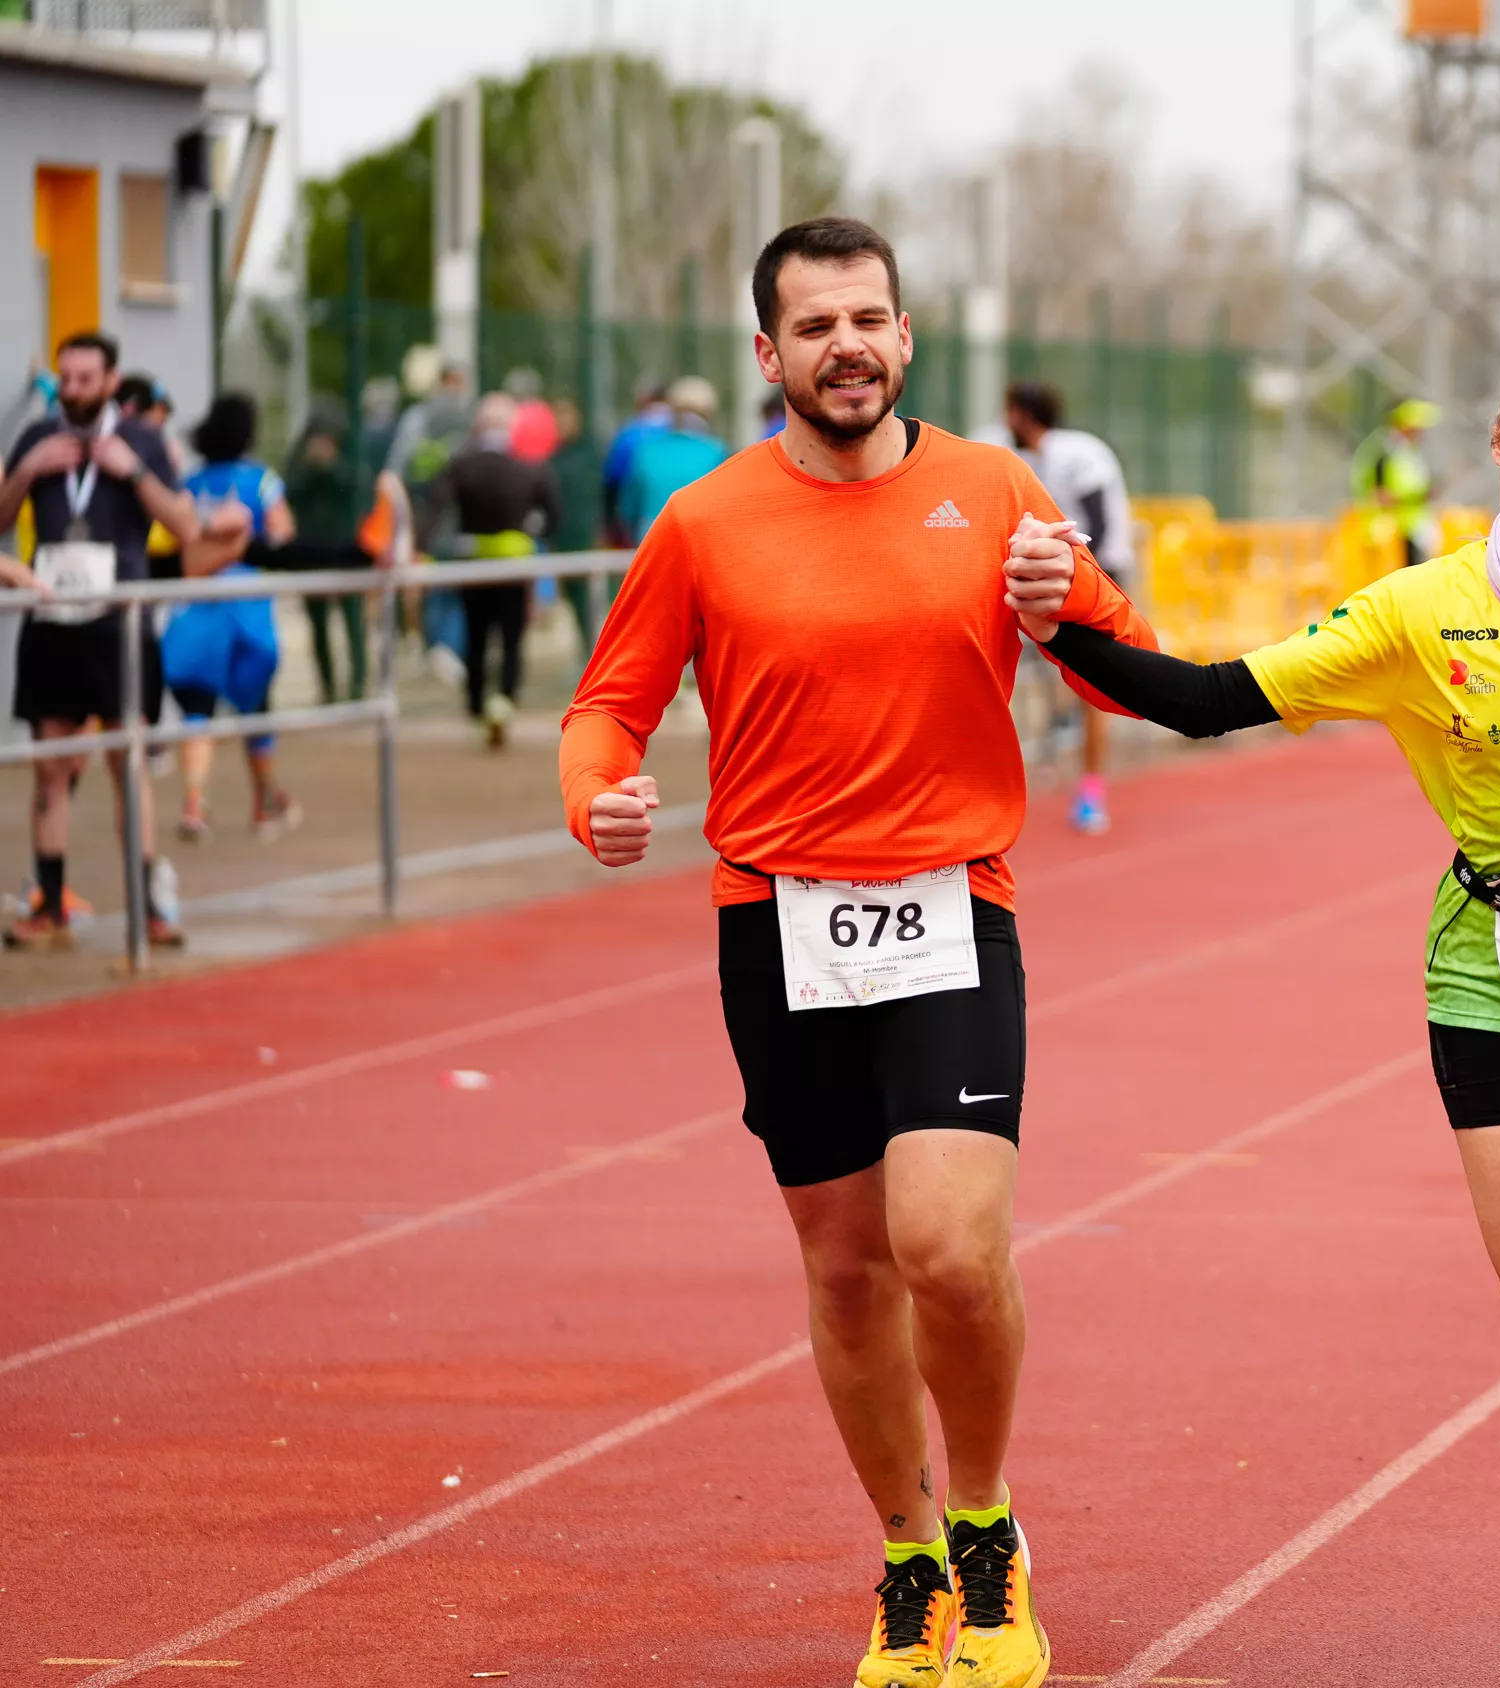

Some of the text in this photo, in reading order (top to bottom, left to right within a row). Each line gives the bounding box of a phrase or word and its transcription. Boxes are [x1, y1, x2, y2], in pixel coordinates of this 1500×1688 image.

[924, 517, 970, 528] adidas
[1441, 628, 1486, 641] emec
[1470, 673, 1486, 685] DS
[1464, 683, 1496, 695] Smith
[829, 902, 926, 948] 678
[901, 951, 932, 961] PACHECO
